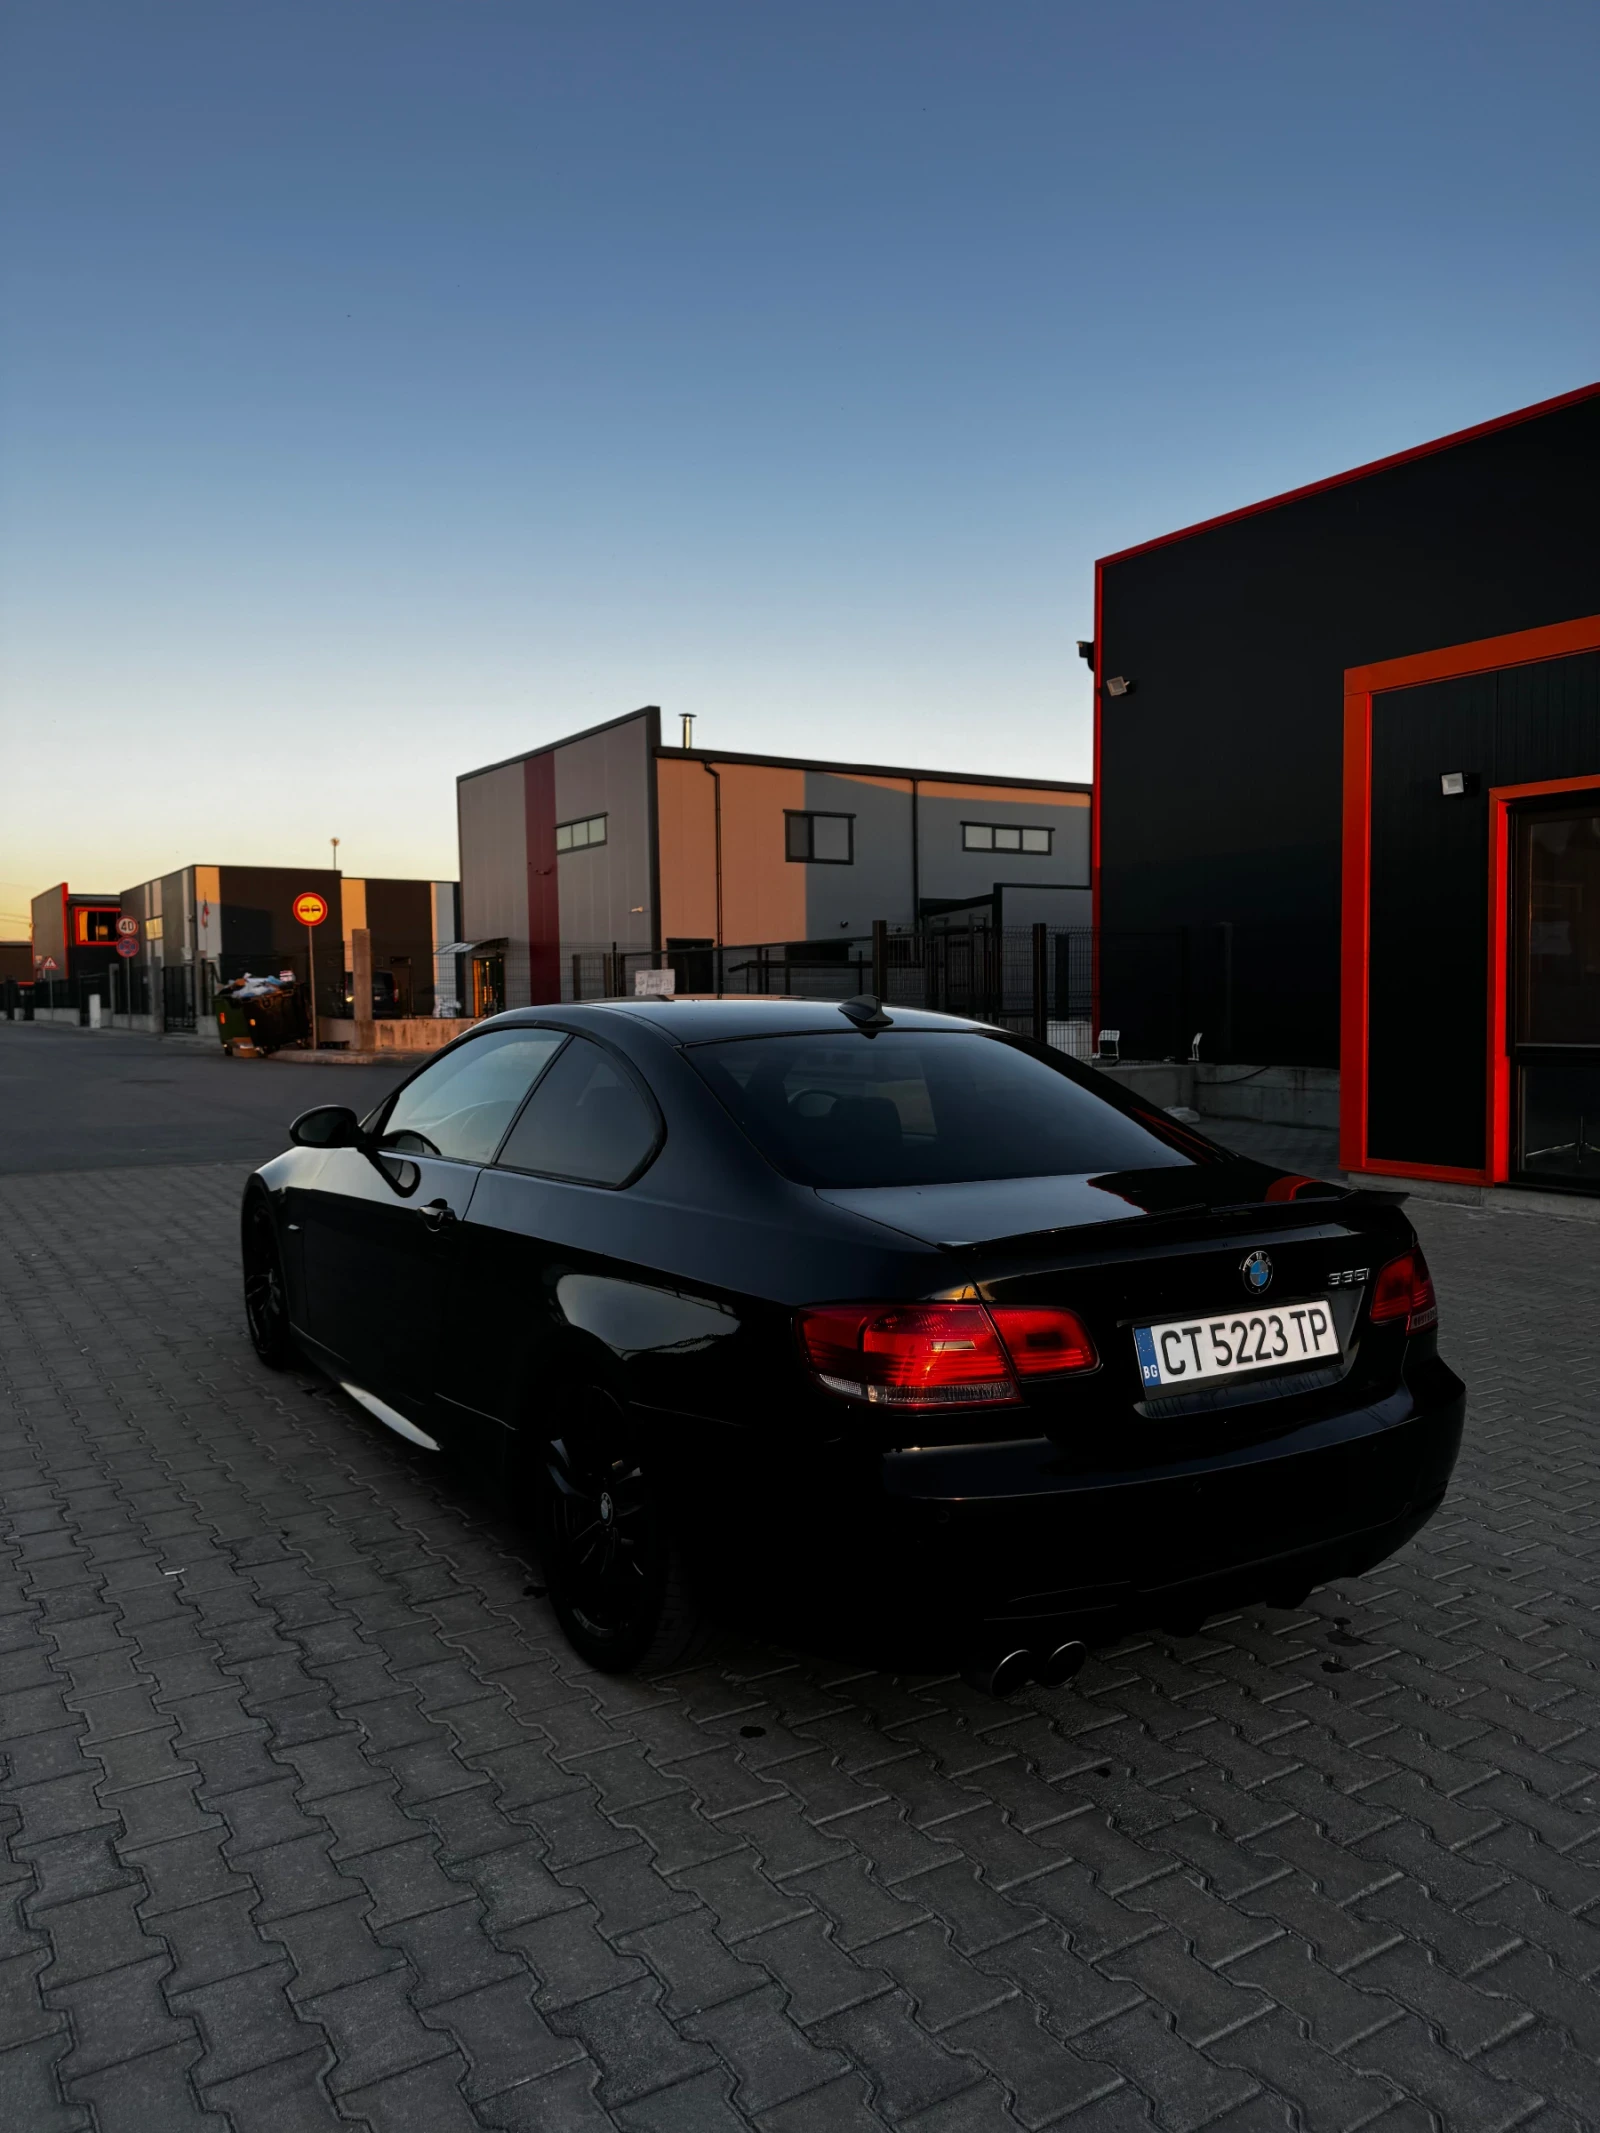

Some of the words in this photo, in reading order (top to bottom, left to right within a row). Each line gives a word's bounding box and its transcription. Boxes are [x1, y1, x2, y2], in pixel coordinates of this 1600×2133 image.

[121, 920, 134, 931] 40
[1160, 1327, 1203, 1376] CT
[1212, 1314, 1289, 1368] 5223
[1290, 1308, 1328, 1353] TP
[1143, 1364, 1158, 1379] BG
